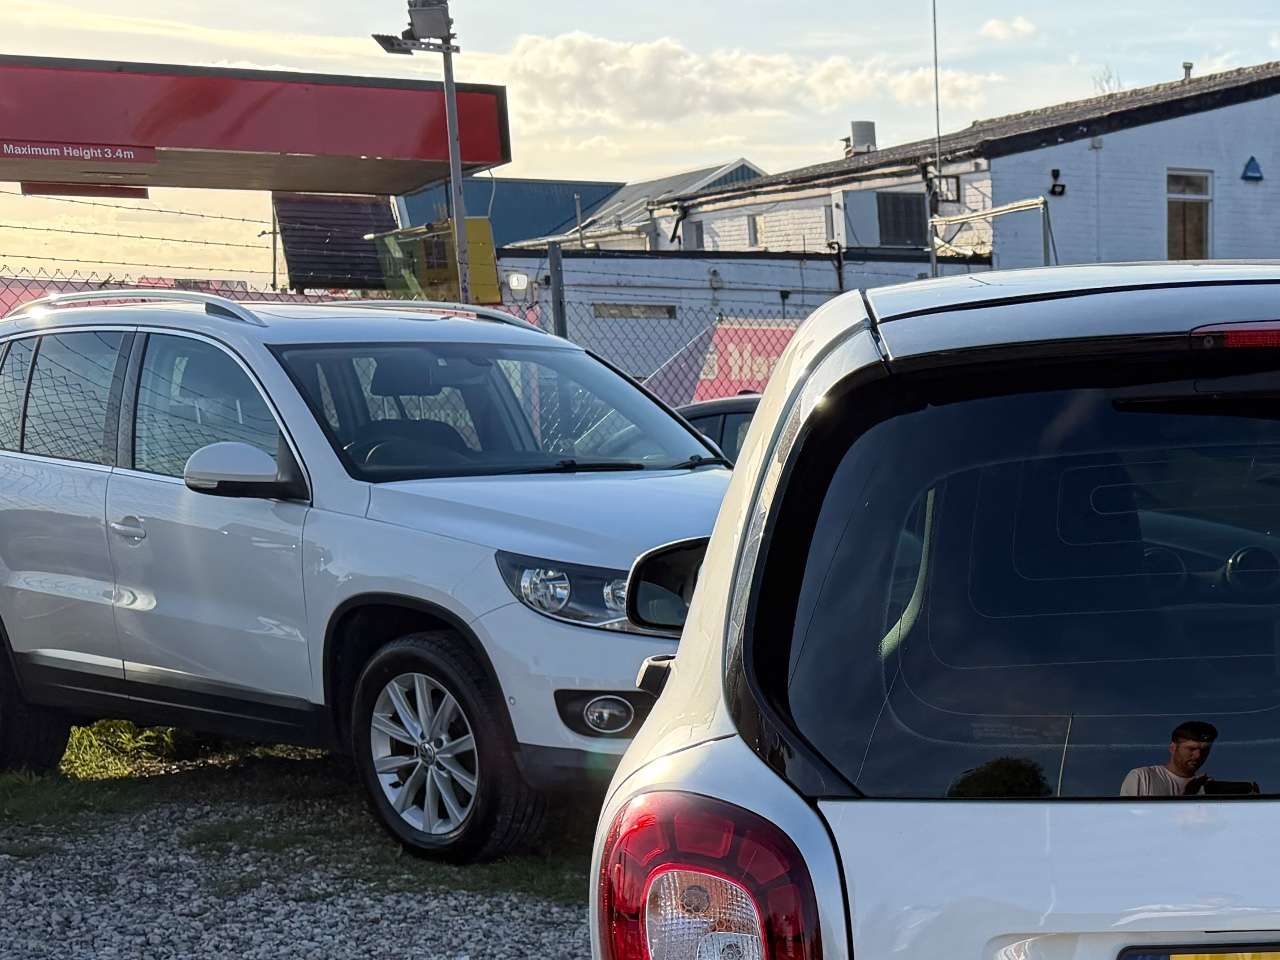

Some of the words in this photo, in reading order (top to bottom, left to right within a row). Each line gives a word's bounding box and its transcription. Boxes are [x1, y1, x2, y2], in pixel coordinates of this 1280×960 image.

[3, 143, 60, 157] Maximum
[63, 146, 102, 160] Height
[104, 147, 135, 159] 3.4m
